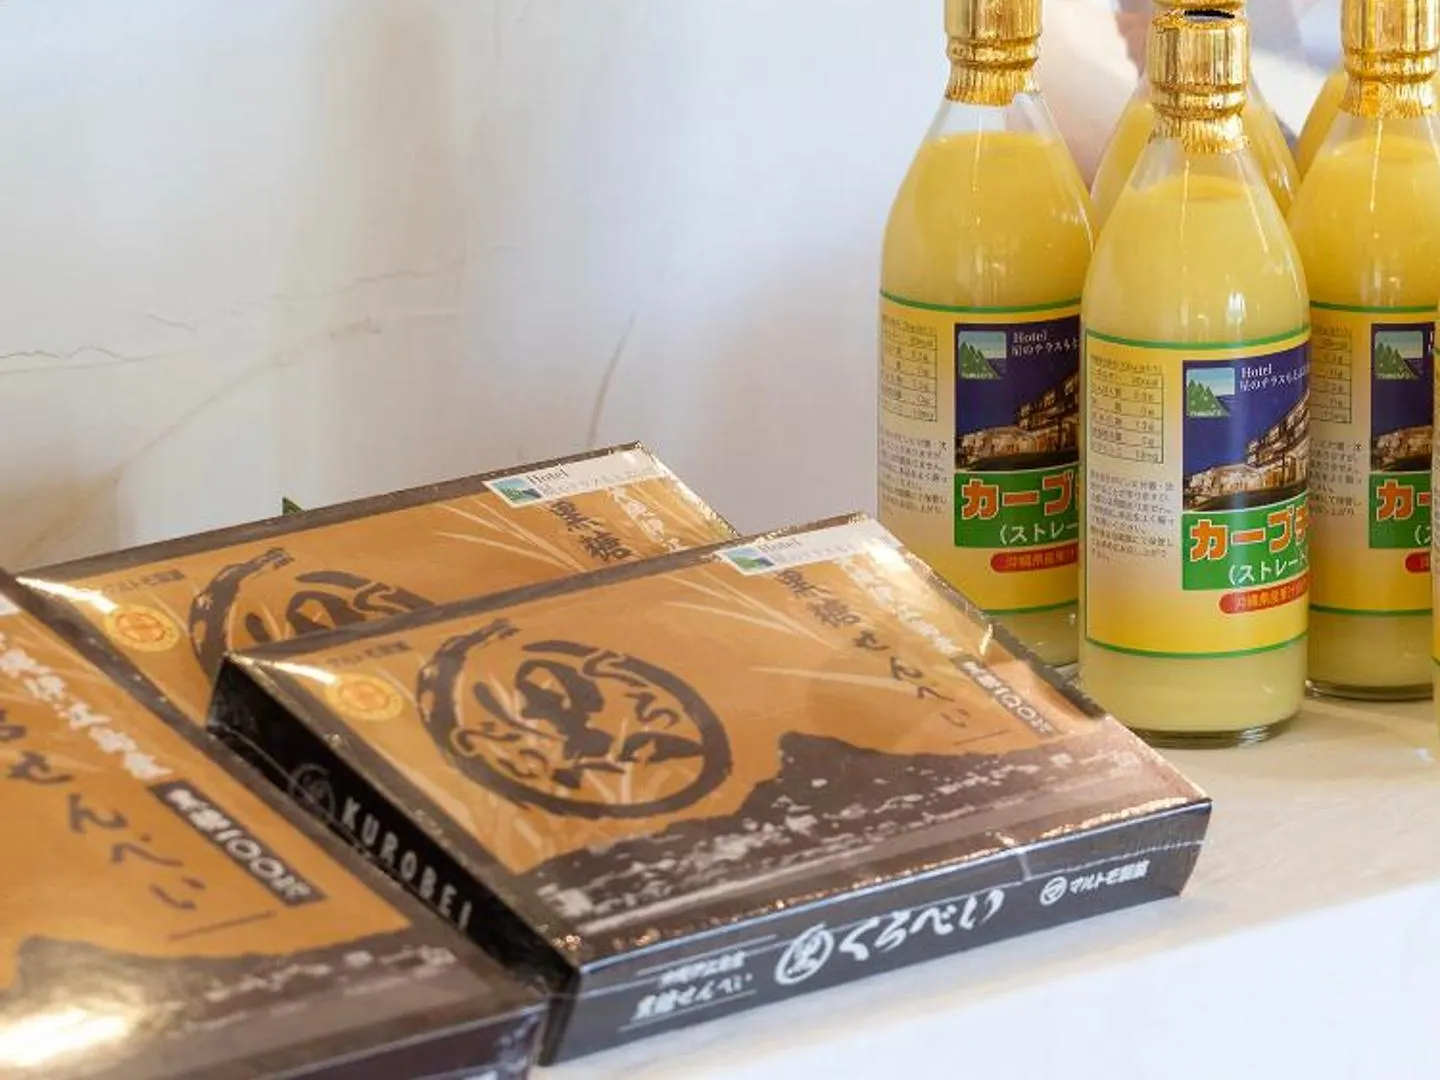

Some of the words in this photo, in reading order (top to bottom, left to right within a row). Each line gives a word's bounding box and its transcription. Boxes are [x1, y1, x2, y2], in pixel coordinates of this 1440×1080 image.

[1013, 330, 1047, 344] Hotel
[1241, 363, 1272, 379] Hotel
[340, 796, 472, 931] KUROBEI
